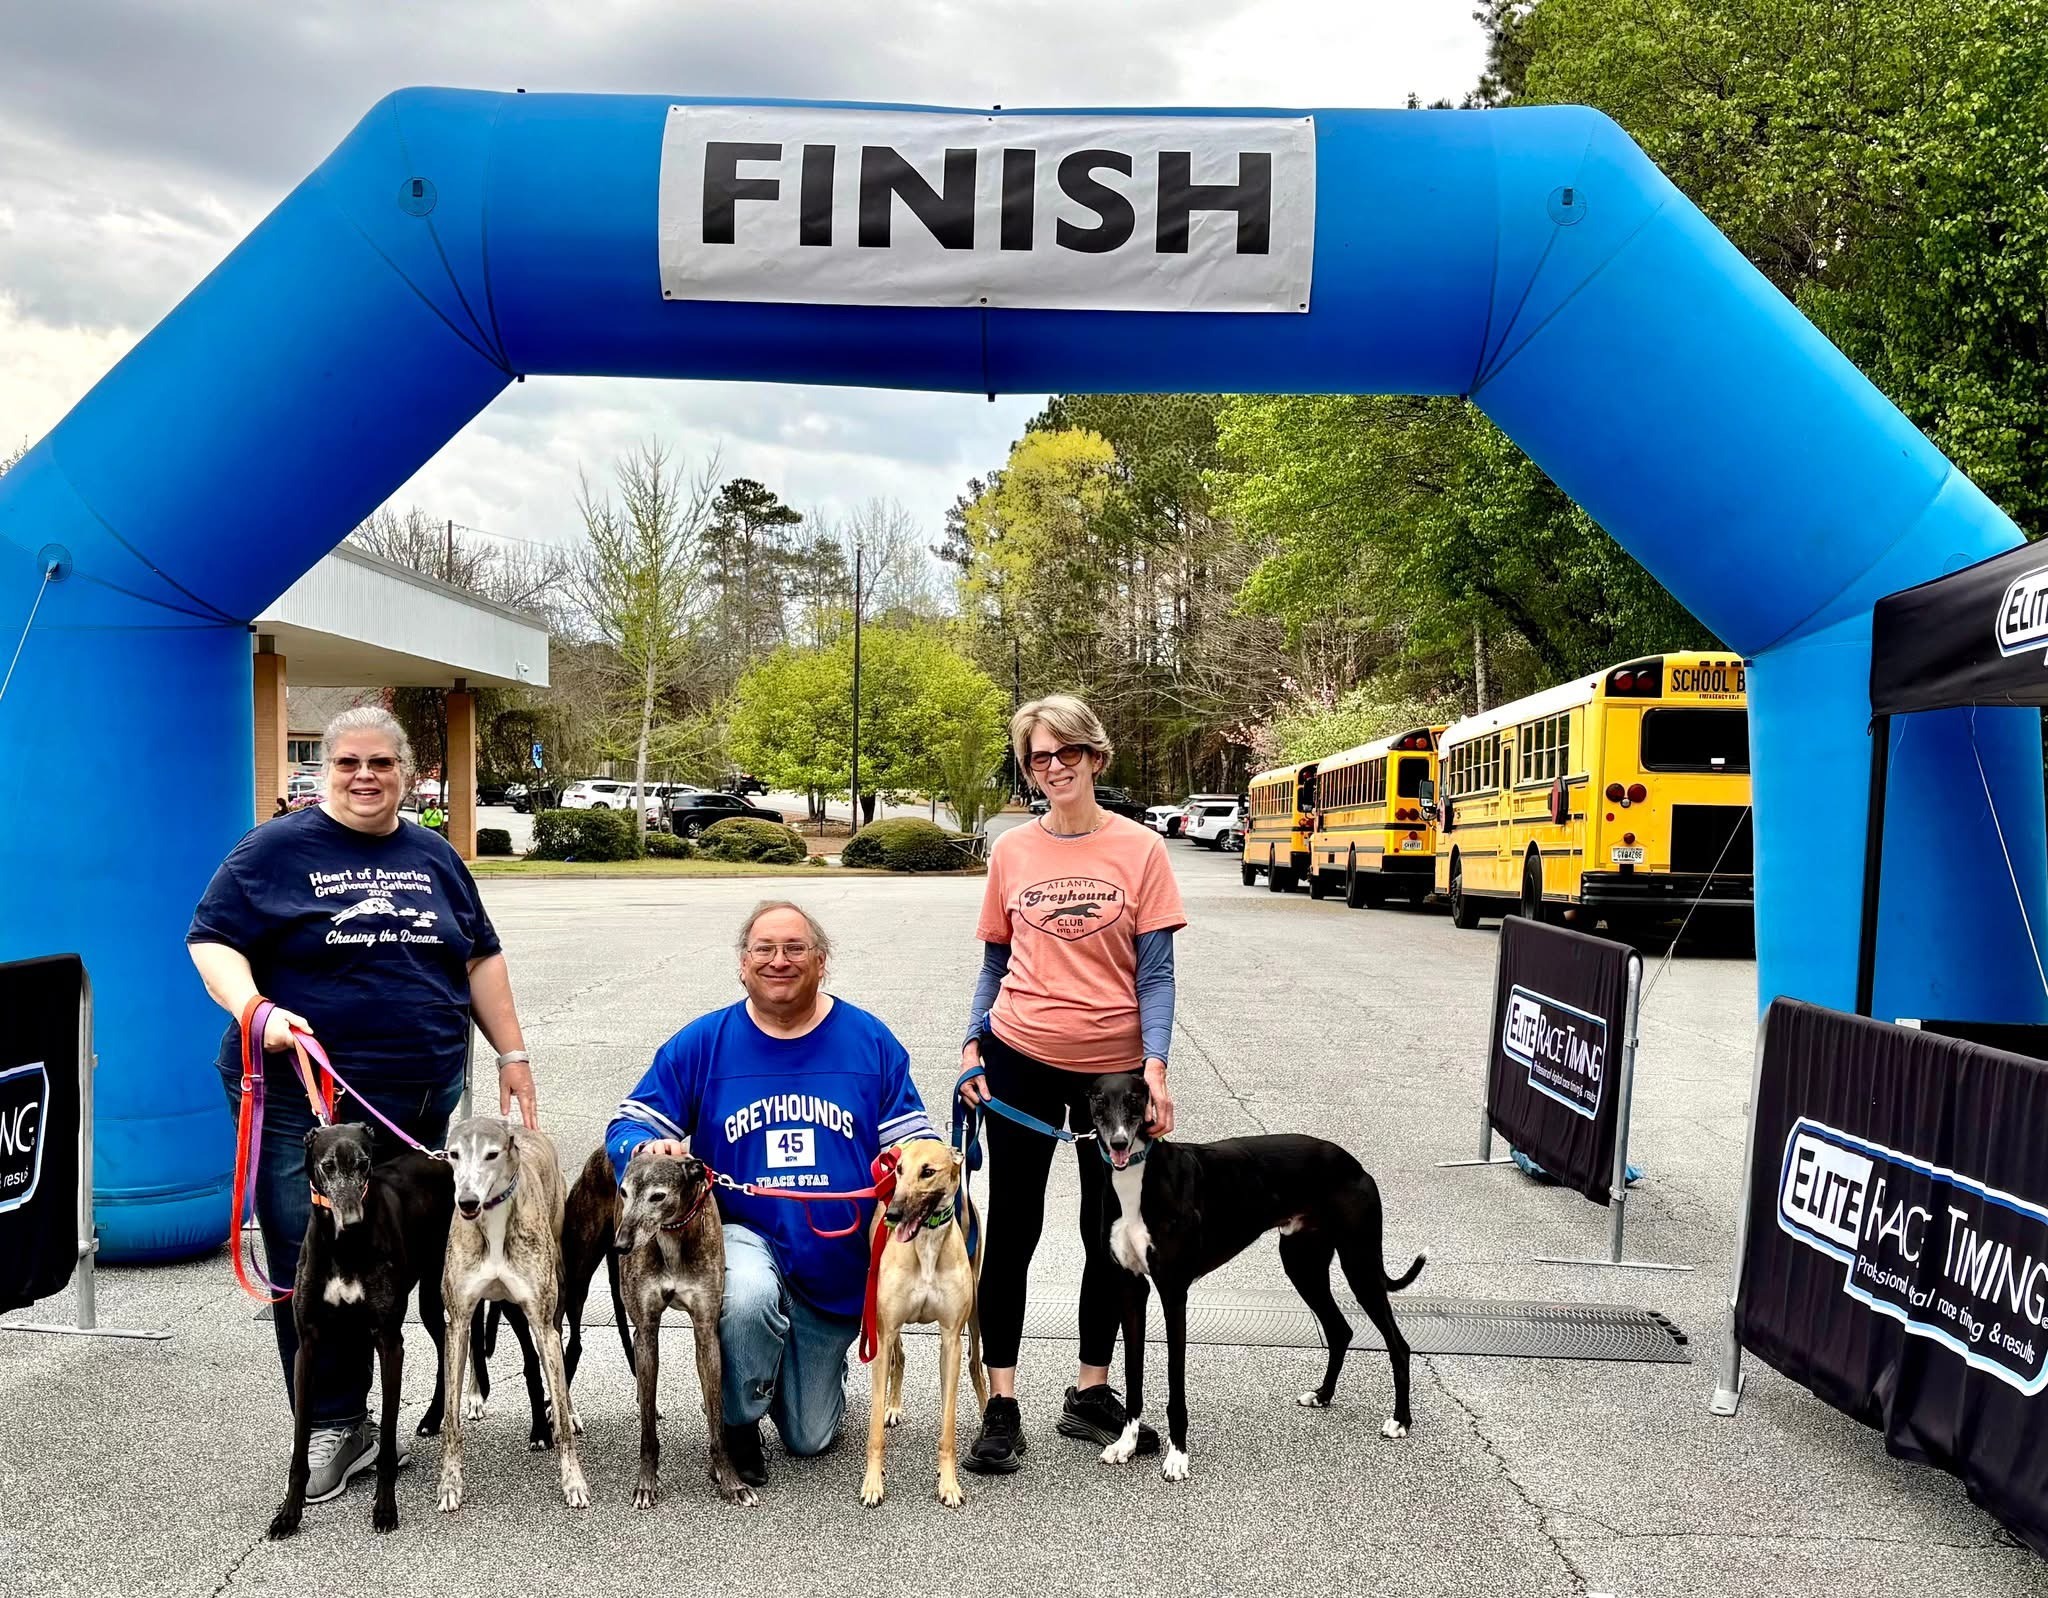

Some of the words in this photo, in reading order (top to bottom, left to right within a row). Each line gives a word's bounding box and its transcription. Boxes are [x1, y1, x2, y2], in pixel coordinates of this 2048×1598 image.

[701, 141, 1272, 255] FINISH
[1671, 668, 1729, 694] SCHOOL
[309, 869, 353, 887] Heart
[356, 868, 372, 880] of
[375, 868, 432, 883] America
[1046, 880, 1096, 890] ATLANTA
[314, 880, 380, 898] Greyhound
[381, 880, 433, 895] Gathering
[1024, 889, 1118, 907] Greyhound
[1057, 918, 1084, 927] CLUB
[325, 929, 377, 947] Chasing
[379, 928, 399, 942] the
[1509, 1002, 1537, 1049] ELITE
[1536, 1013, 1566, 1064] RACE
[724, 1094, 854, 1144] GREYHOUNDS
[777, 1132, 804, 1154] 45
[755, 1174, 796, 1188] TRACK
[797, 1174, 829, 1187] STAR
[1791, 1147, 1863, 1235] ELITE
[1943, 1204, 2048, 1325] TIMING
[1988, 1322, 2001, 1345] &
[2002, 1333, 2036, 1365] results
